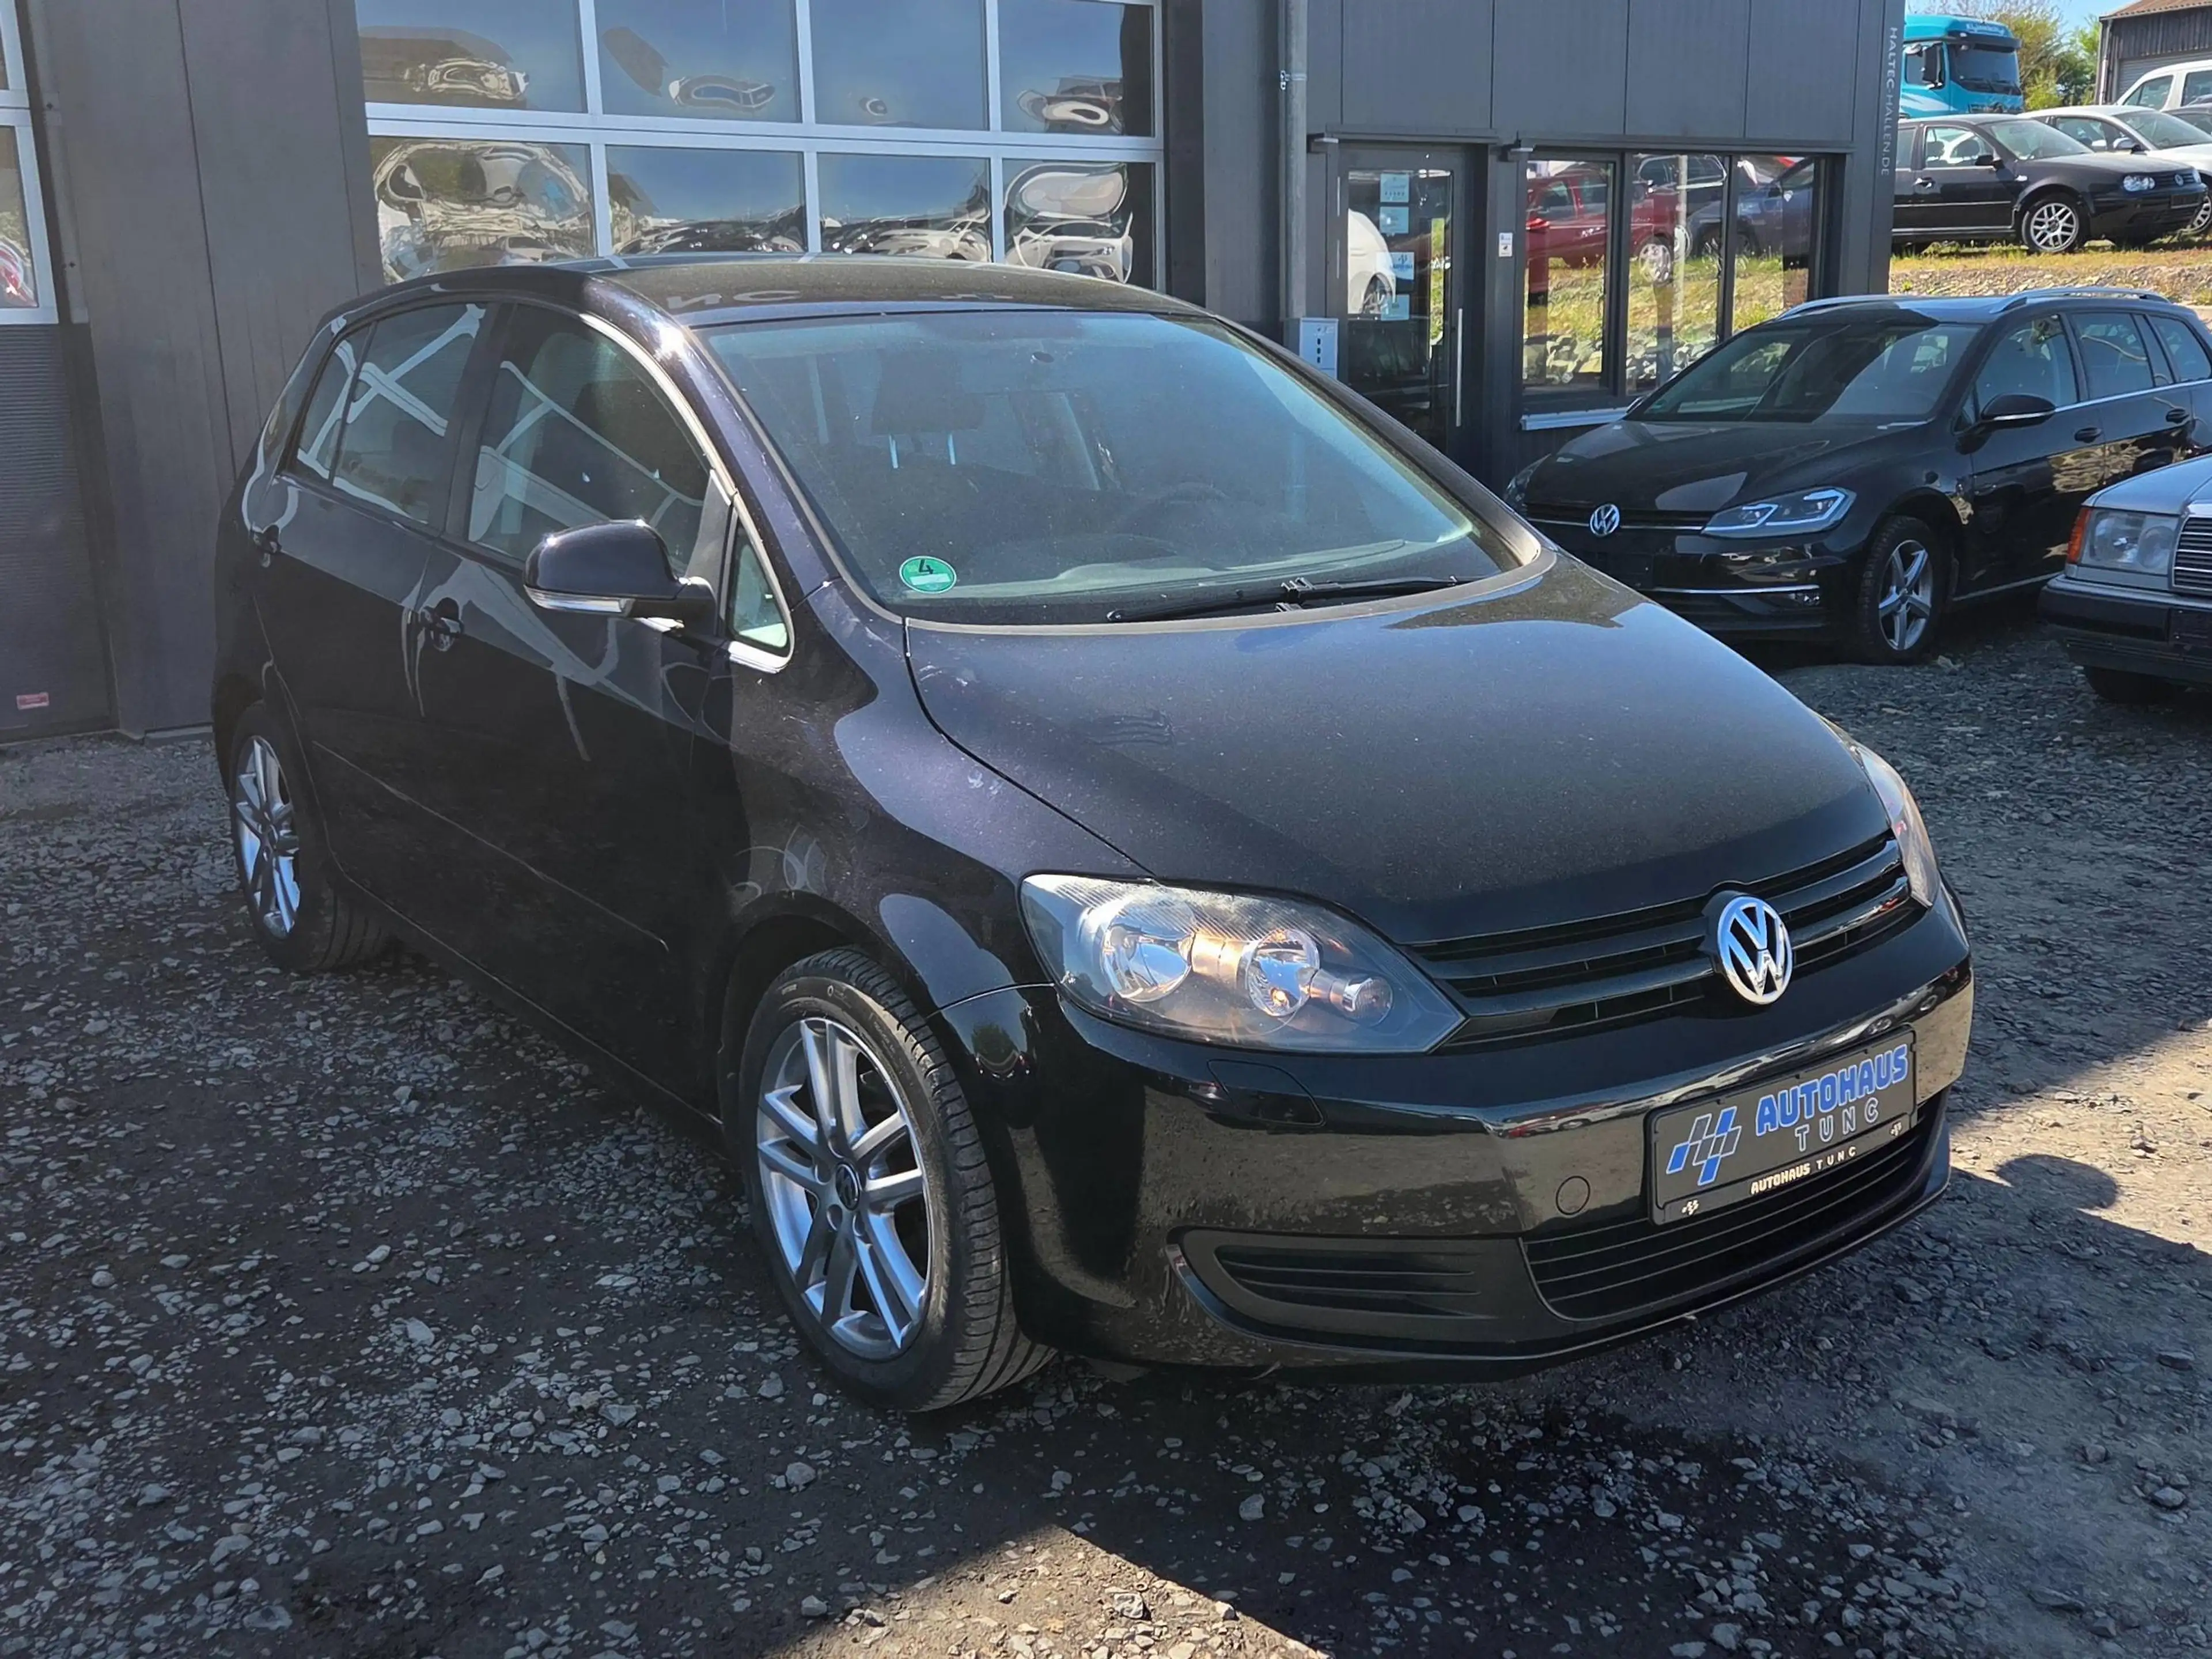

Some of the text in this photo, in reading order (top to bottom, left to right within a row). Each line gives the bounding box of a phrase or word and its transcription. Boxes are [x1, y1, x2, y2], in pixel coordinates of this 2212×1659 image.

[1881, 26, 1899, 176] HALTEC-HALLEN.DE
[918, 559, 934, 574] 4
[1718, 897, 1792, 1004] VW
[1755, 1043, 1908, 1137] AUTOHAUS
[1794, 1097, 1880, 1152] TUNC
[1750, 1146, 1857, 1195] AUTOHAUS TUNC
